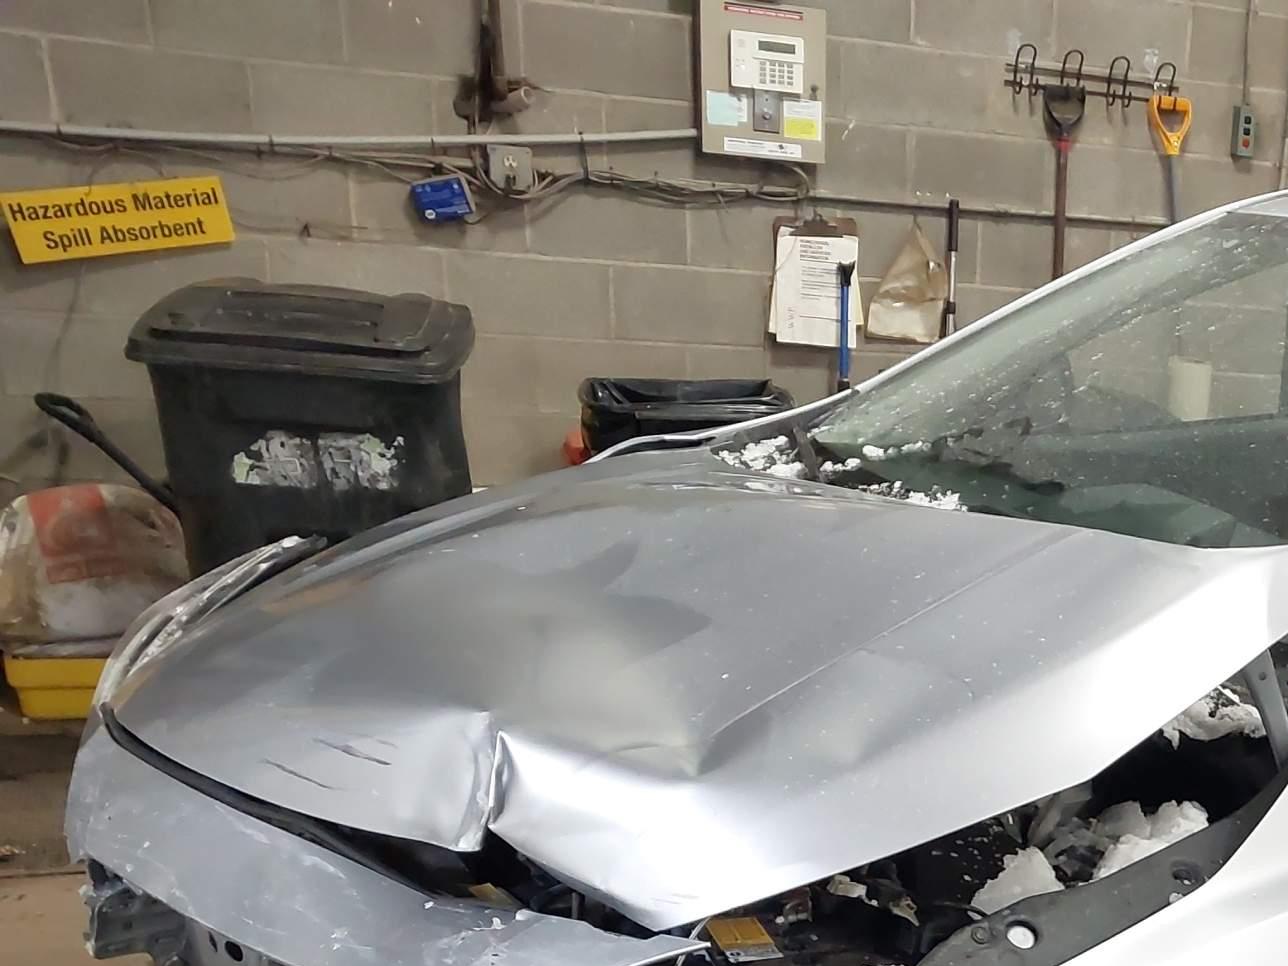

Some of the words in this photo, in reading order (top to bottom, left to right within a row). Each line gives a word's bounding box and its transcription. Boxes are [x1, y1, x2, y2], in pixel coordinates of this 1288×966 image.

[8, 197, 128, 222] Hazardous
[131, 187, 220, 212] Material
[43, 227, 93, 252] Spill
[100, 217, 206, 244] Absorbent
